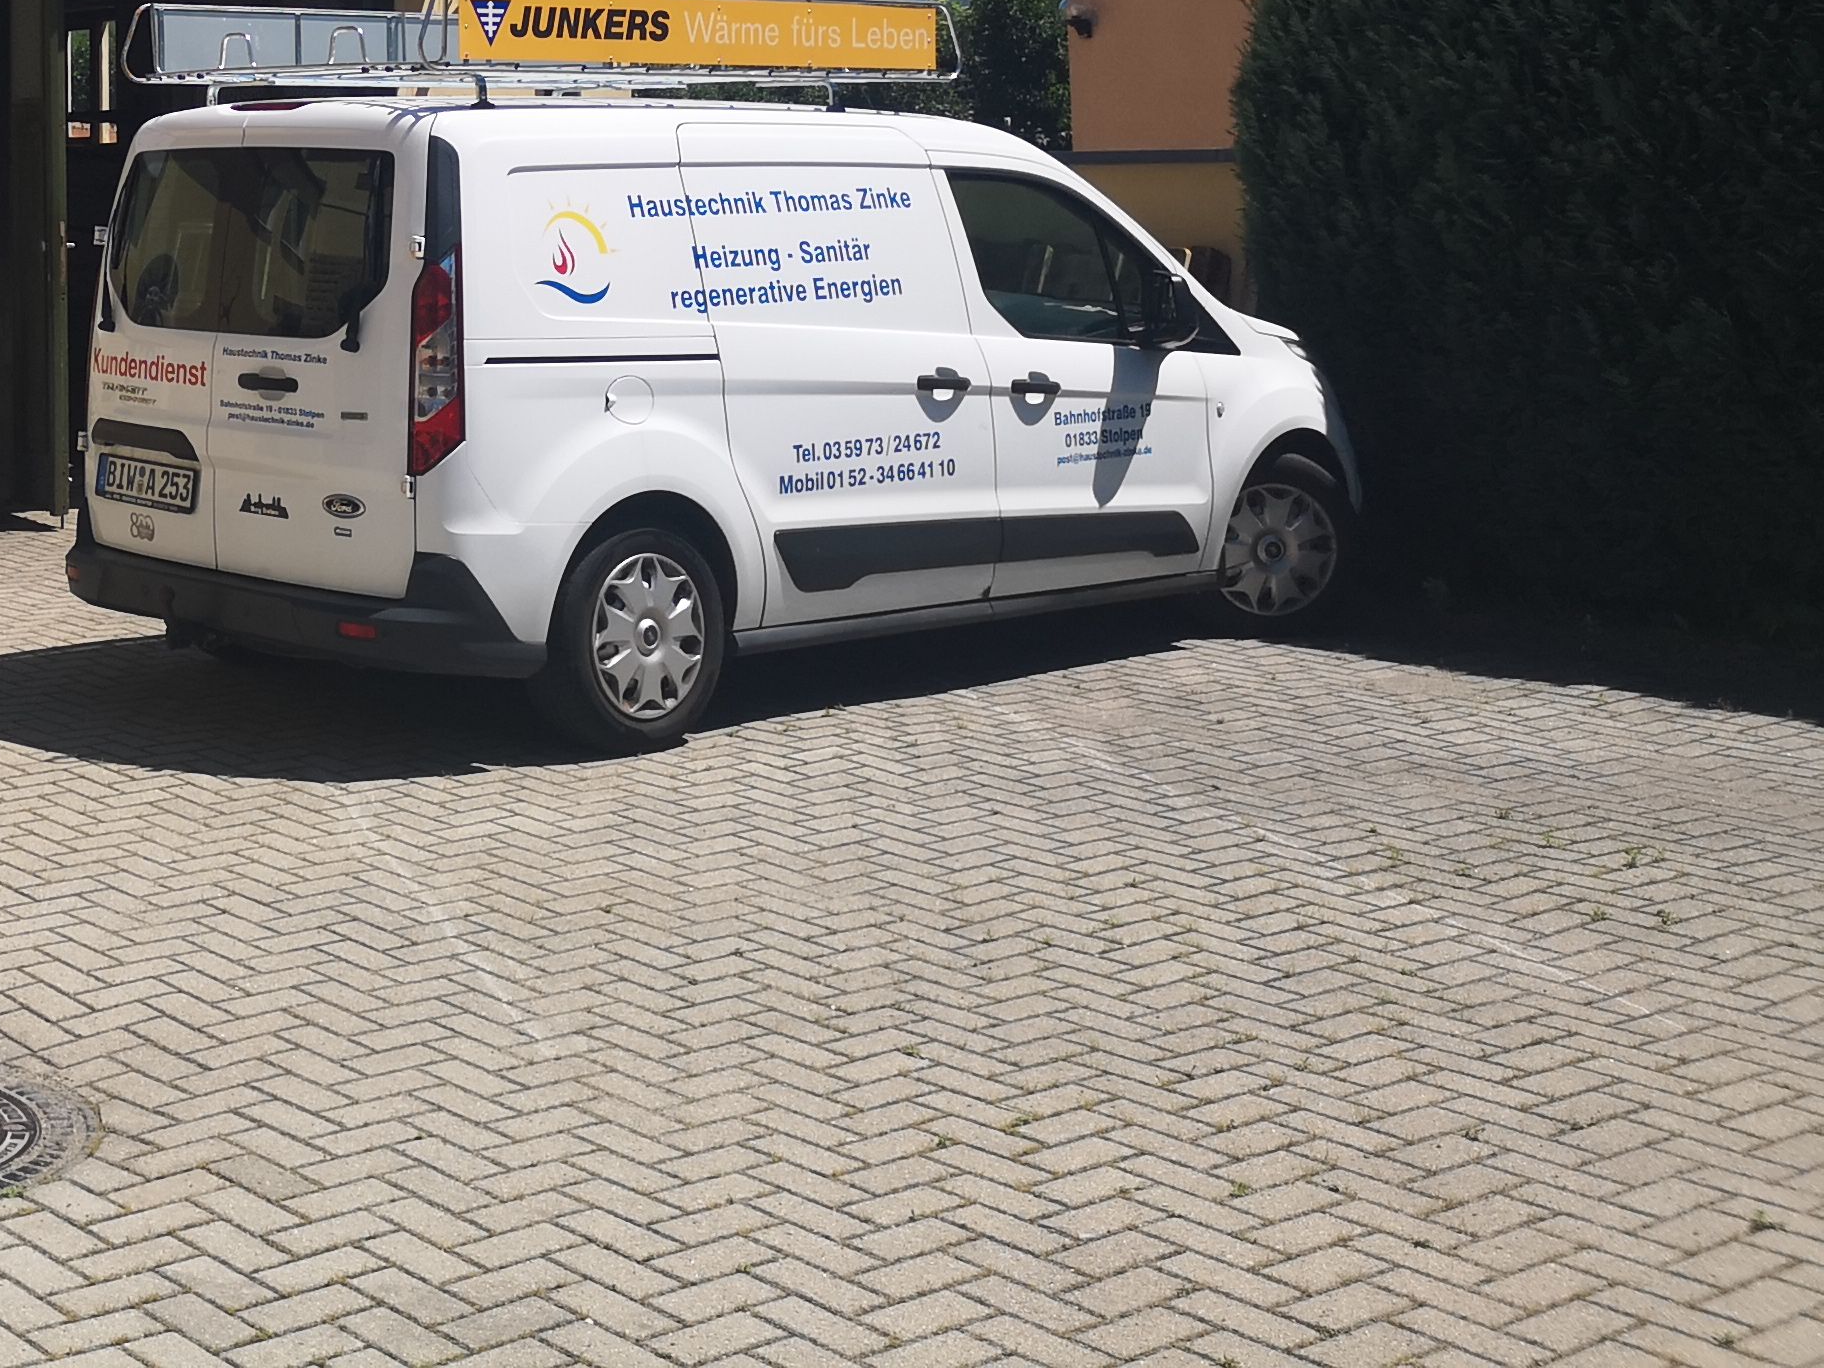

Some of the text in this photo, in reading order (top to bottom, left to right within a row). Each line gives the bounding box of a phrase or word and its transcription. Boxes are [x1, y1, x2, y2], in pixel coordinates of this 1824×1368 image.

[509, 5, 929, 50] JUNKERS Wärme fürs Leben
[627, 187, 912, 218] Haustechnik Thomas Zinke
[692, 244, 782, 273] Heizung
[799, 238, 872, 265] Sanitär
[670, 275, 903, 314] regenerative Energien
[92, 347, 207, 387] Kundendienst
[222, 346, 328, 365] Haustechnik Thomas Zinke
[1054, 402, 1152, 426] Bahnhofstraße 19
[792, 442, 821, 464] Tel.
[1065, 428, 1143, 448] 01833 Stolpen
[106, 460, 137, 492] BIW
[144, 468, 156, 497] A
[158, 470, 192, 502] 253
[778, 471, 825, 495] Mobil
